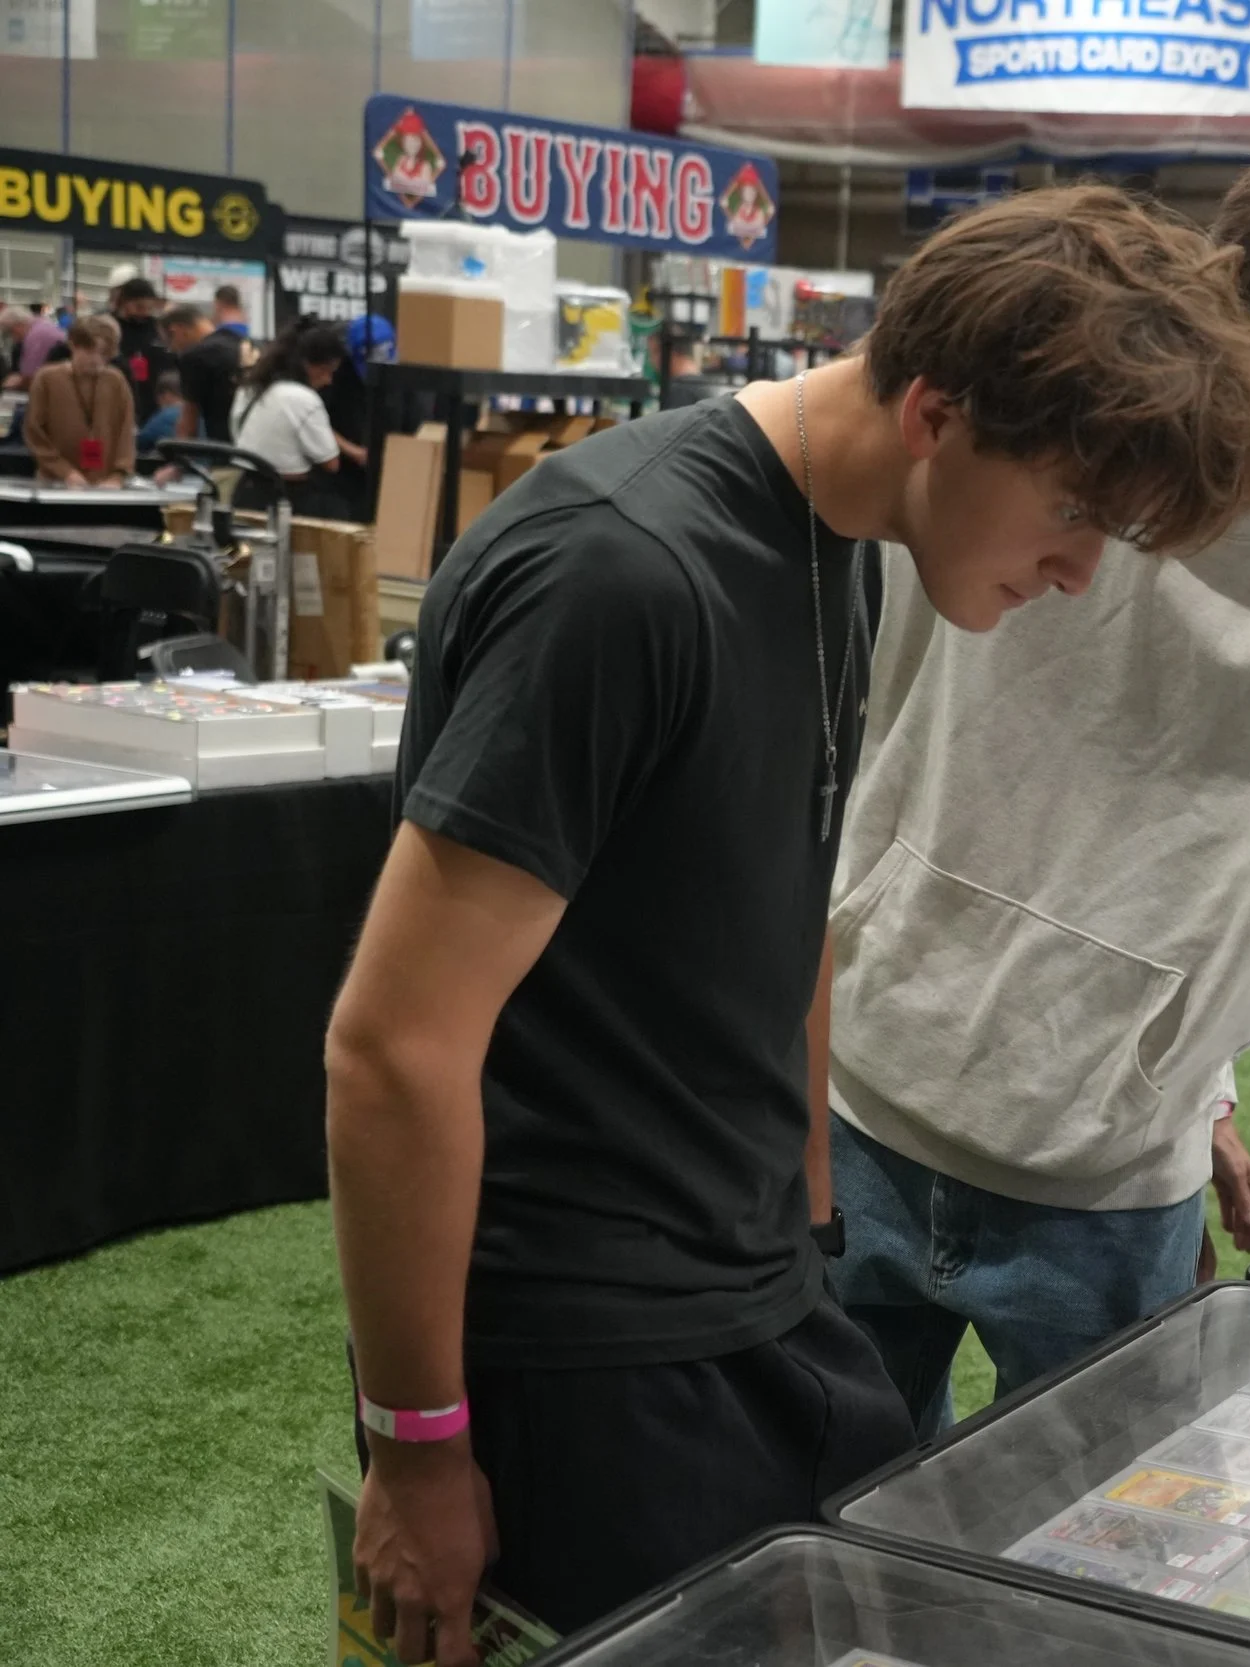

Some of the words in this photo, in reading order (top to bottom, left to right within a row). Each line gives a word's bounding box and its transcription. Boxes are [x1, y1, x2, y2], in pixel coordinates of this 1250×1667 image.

[968, 37, 1078, 79] SPORTS
[1080, 37, 1161, 73] CARD
[1162, 41, 1240, 82] EXPO
[0, 166, 206, 238] BUYING
[455, 119, 714, 245] BUYING
[279, 264, 328, 294] WE
